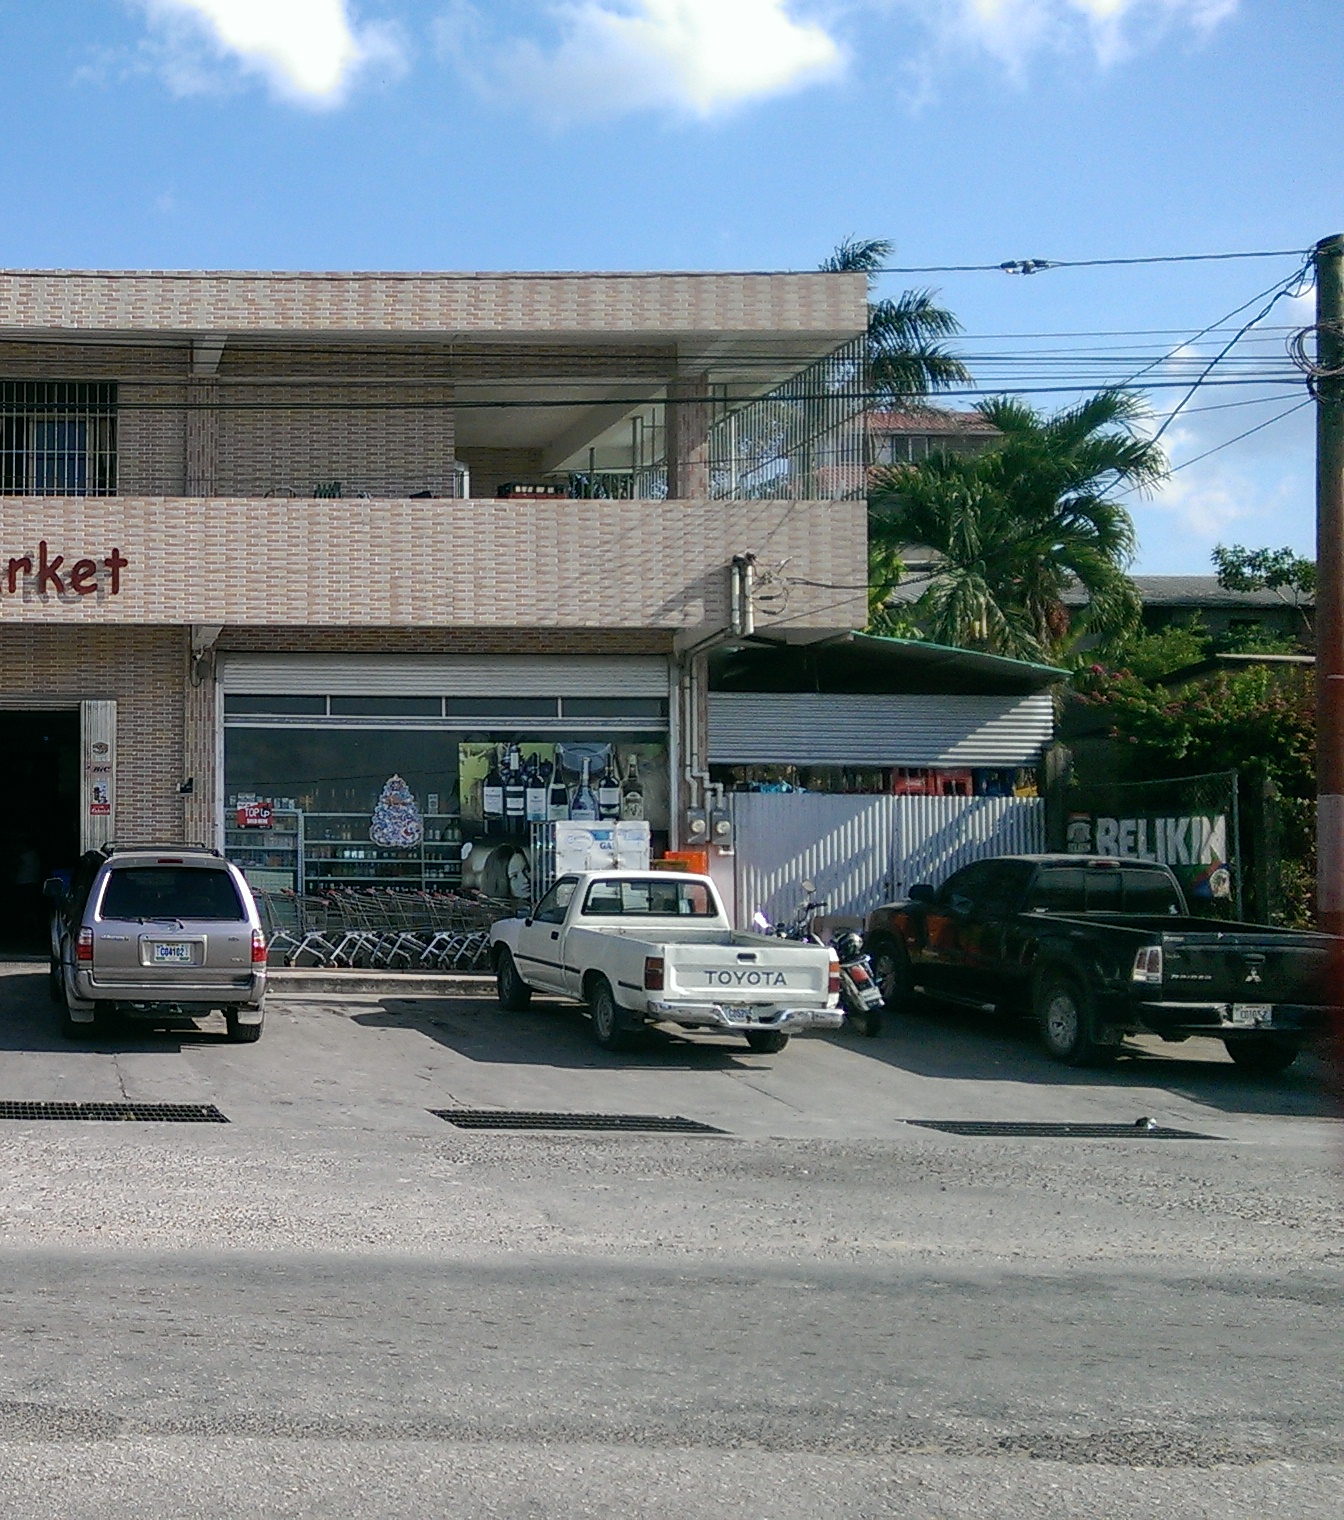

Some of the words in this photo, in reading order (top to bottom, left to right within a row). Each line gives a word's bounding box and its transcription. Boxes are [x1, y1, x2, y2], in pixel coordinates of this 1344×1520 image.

[244, 807, 260, 817] TOP
[1096, 815, 1226, 865] BELIKIN
[704, 970, 787, 986] TOYOTA
